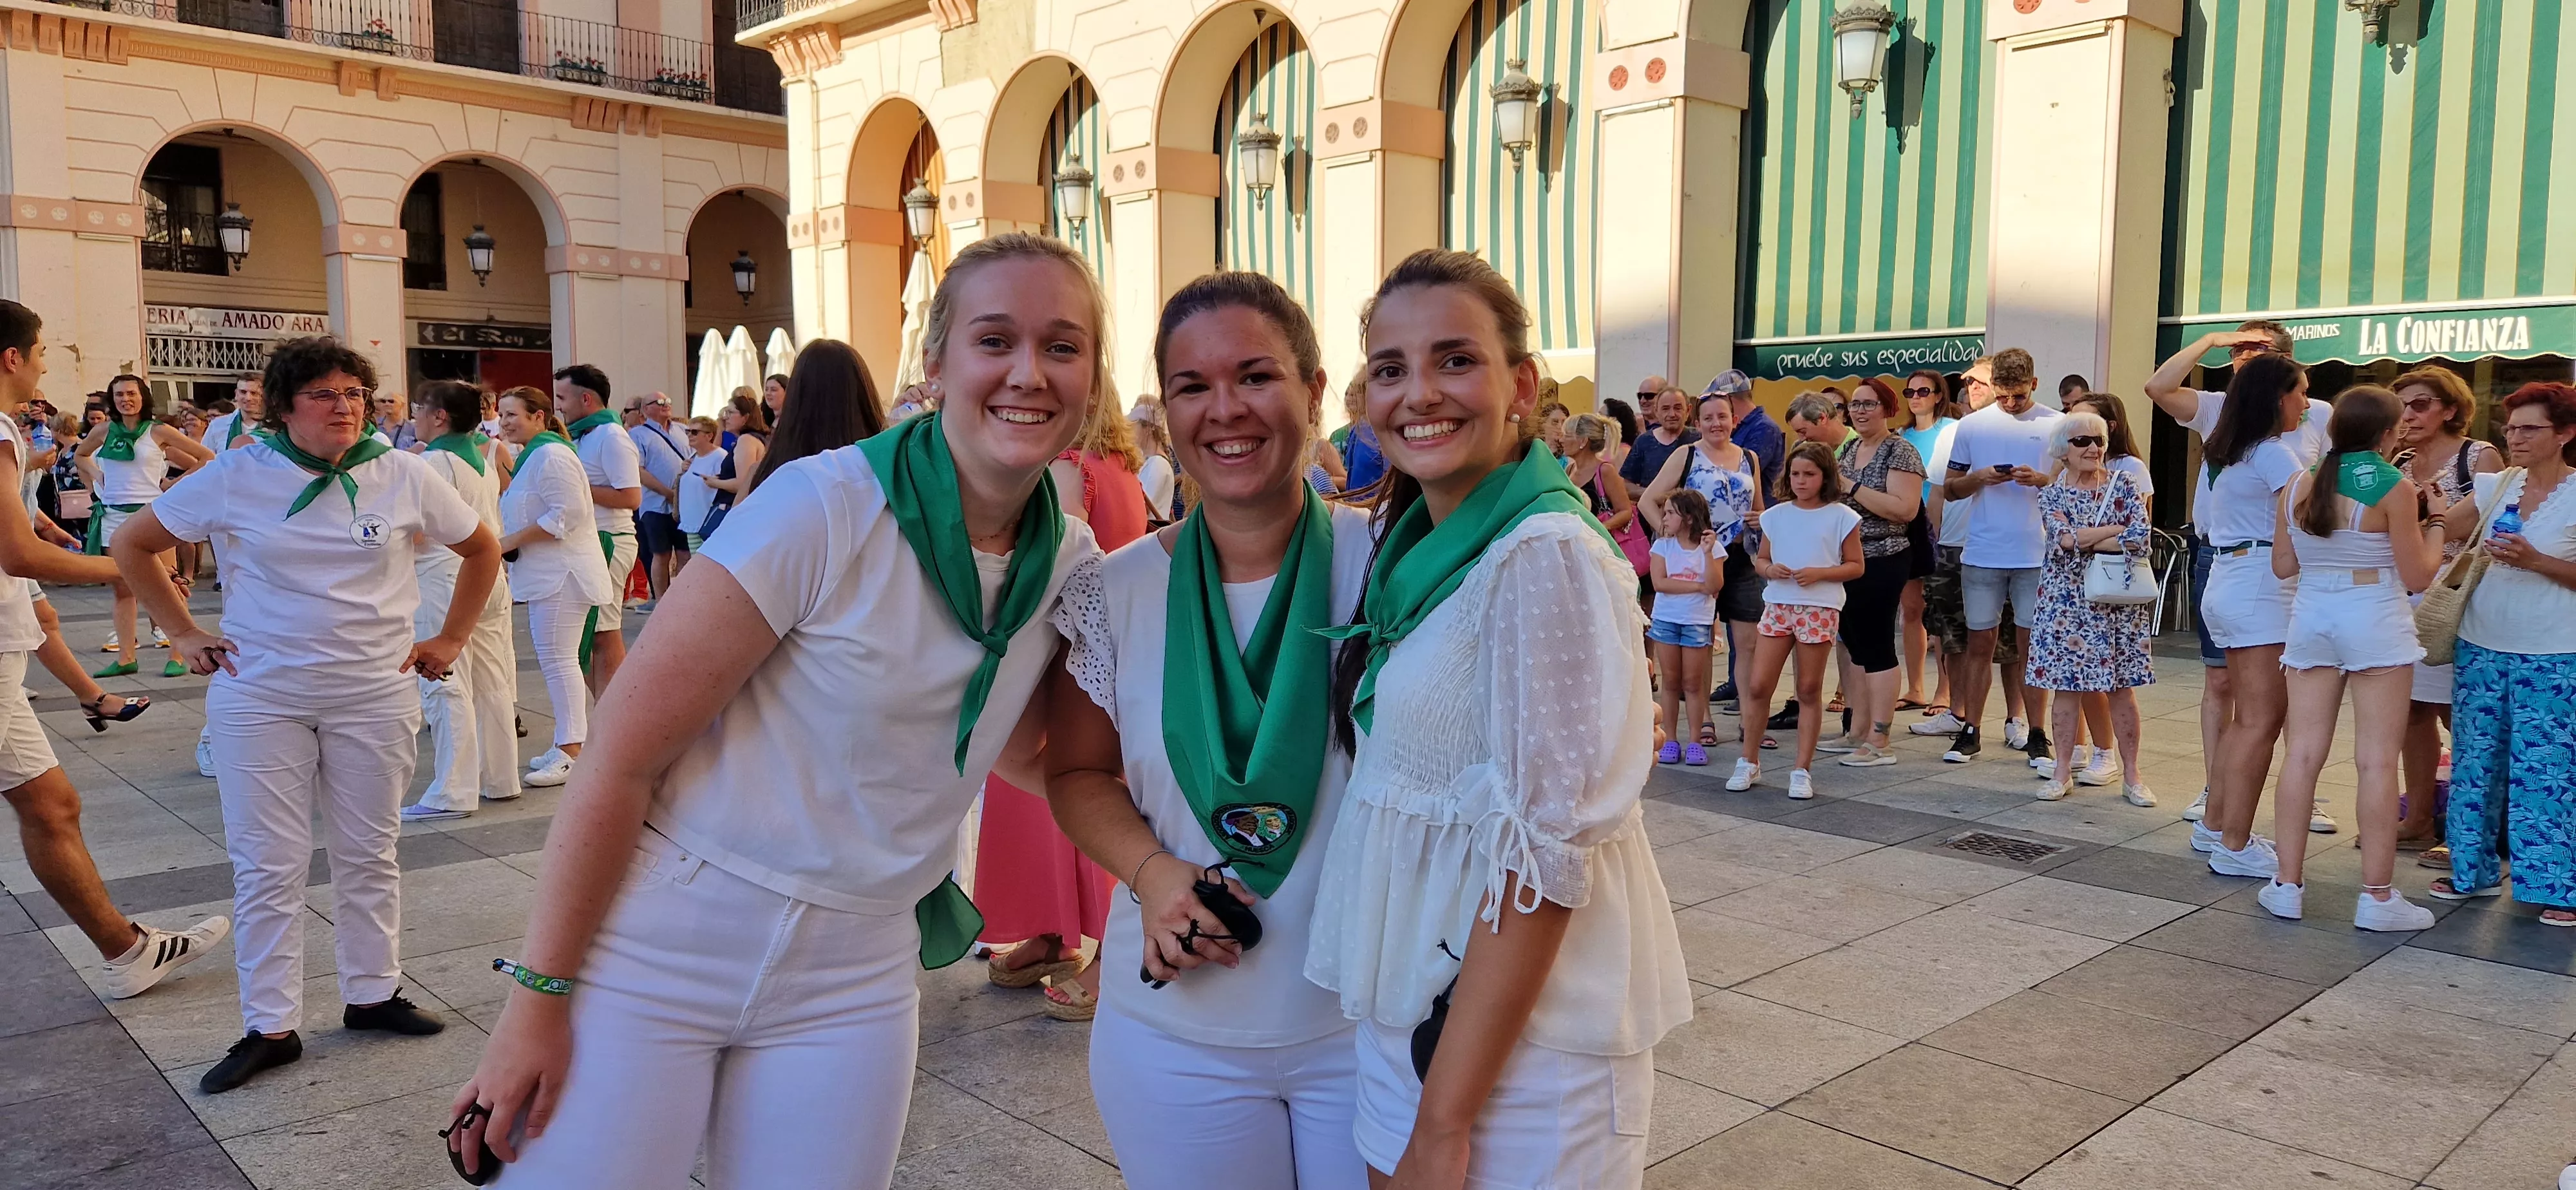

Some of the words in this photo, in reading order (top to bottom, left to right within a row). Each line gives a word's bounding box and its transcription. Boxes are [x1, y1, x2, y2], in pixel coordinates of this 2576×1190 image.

[222, 312, 284, 330] AMADO
[291, 316, 324, 333] ARA
[2286, 323, 2340, 341] MARINOS
[475, 328, 524, 346] Rey
[2358, 318, 2388, 355] LA
[2396, 316, 2530, 354] CONFIANZA
[1777, 346, 1833, 376] pruebe
[1840, 350, 1868, 367] sus
[1877, 339, 1985, 373] especialidad
